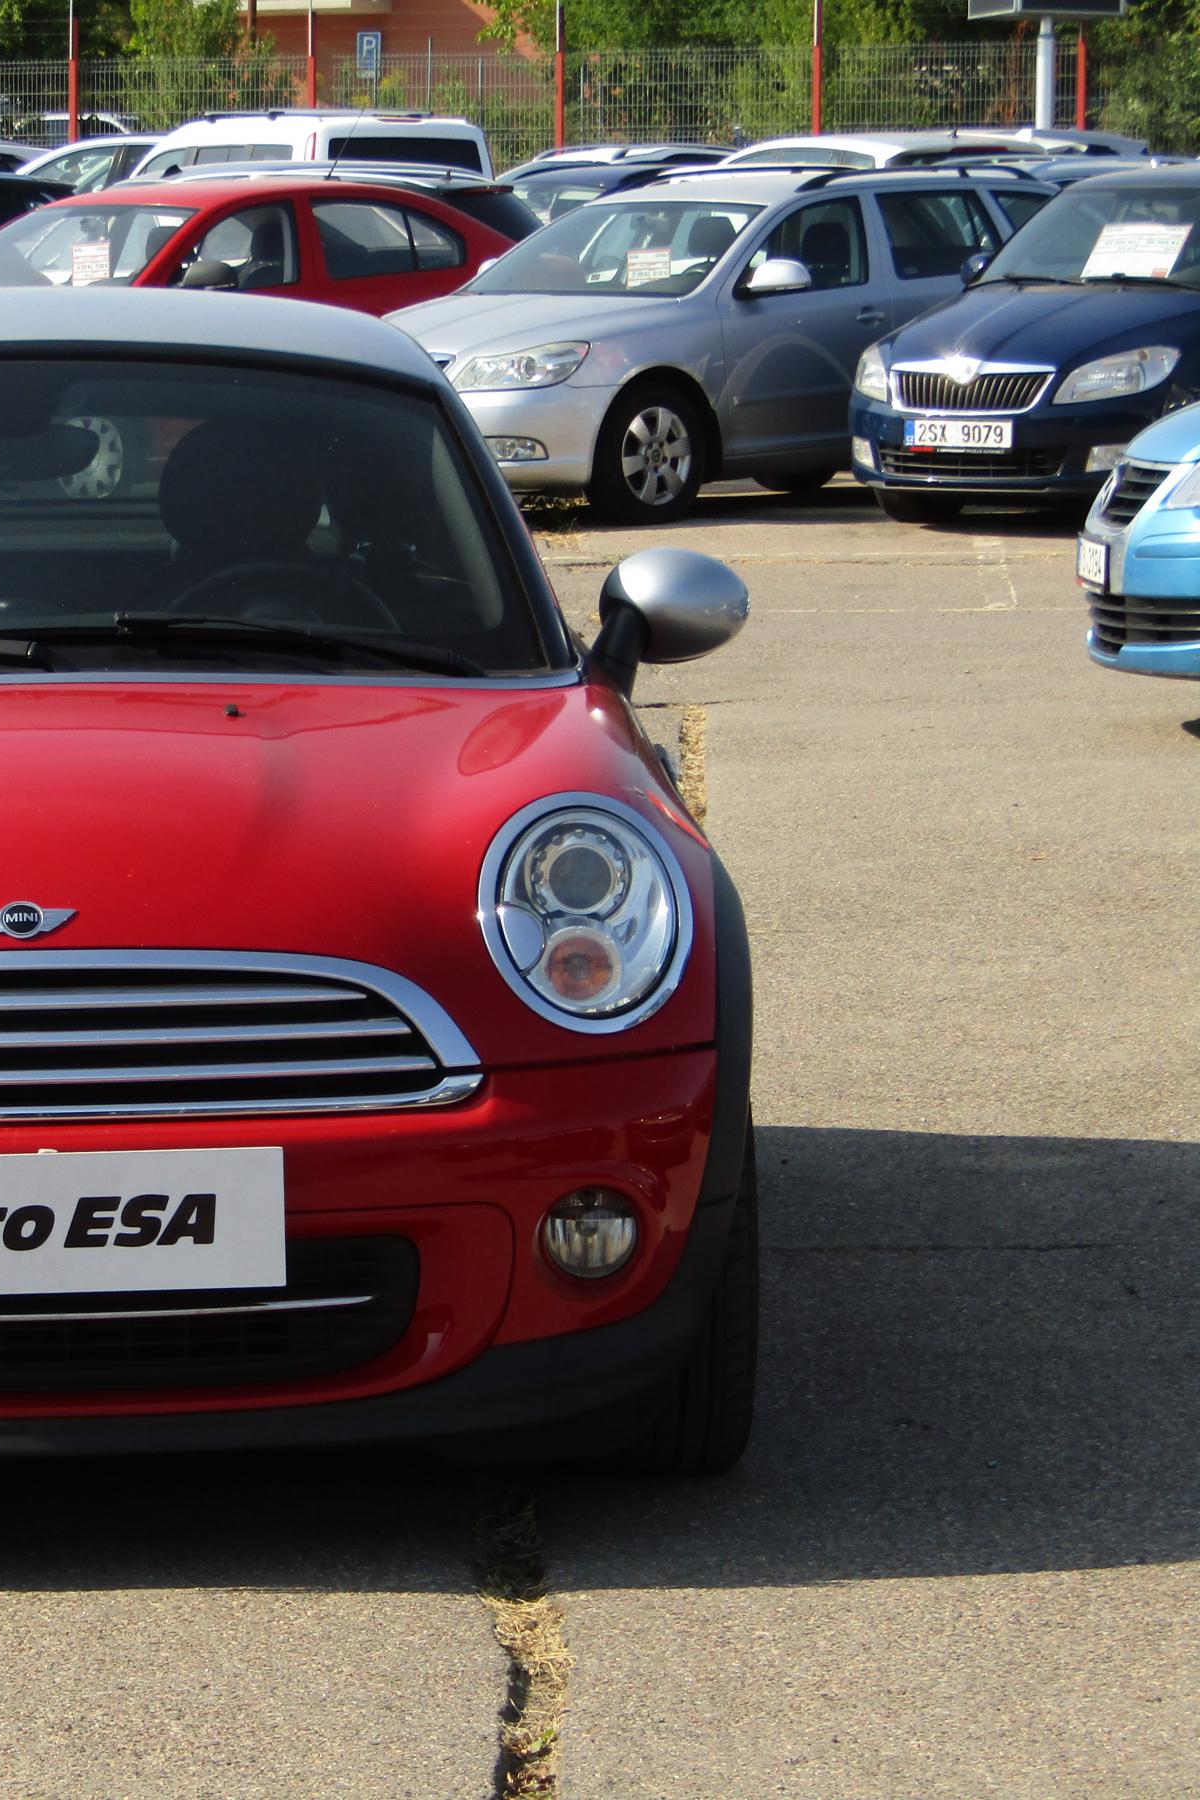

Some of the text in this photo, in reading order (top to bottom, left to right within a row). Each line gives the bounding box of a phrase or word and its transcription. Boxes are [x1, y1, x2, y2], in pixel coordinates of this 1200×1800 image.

[363, 37, 376, 56] P
[917, 423, 1004, 445] 2SX 9079
[5, 912, 38, 923] MINI
[63, 1193, 216, 1248] ESA
